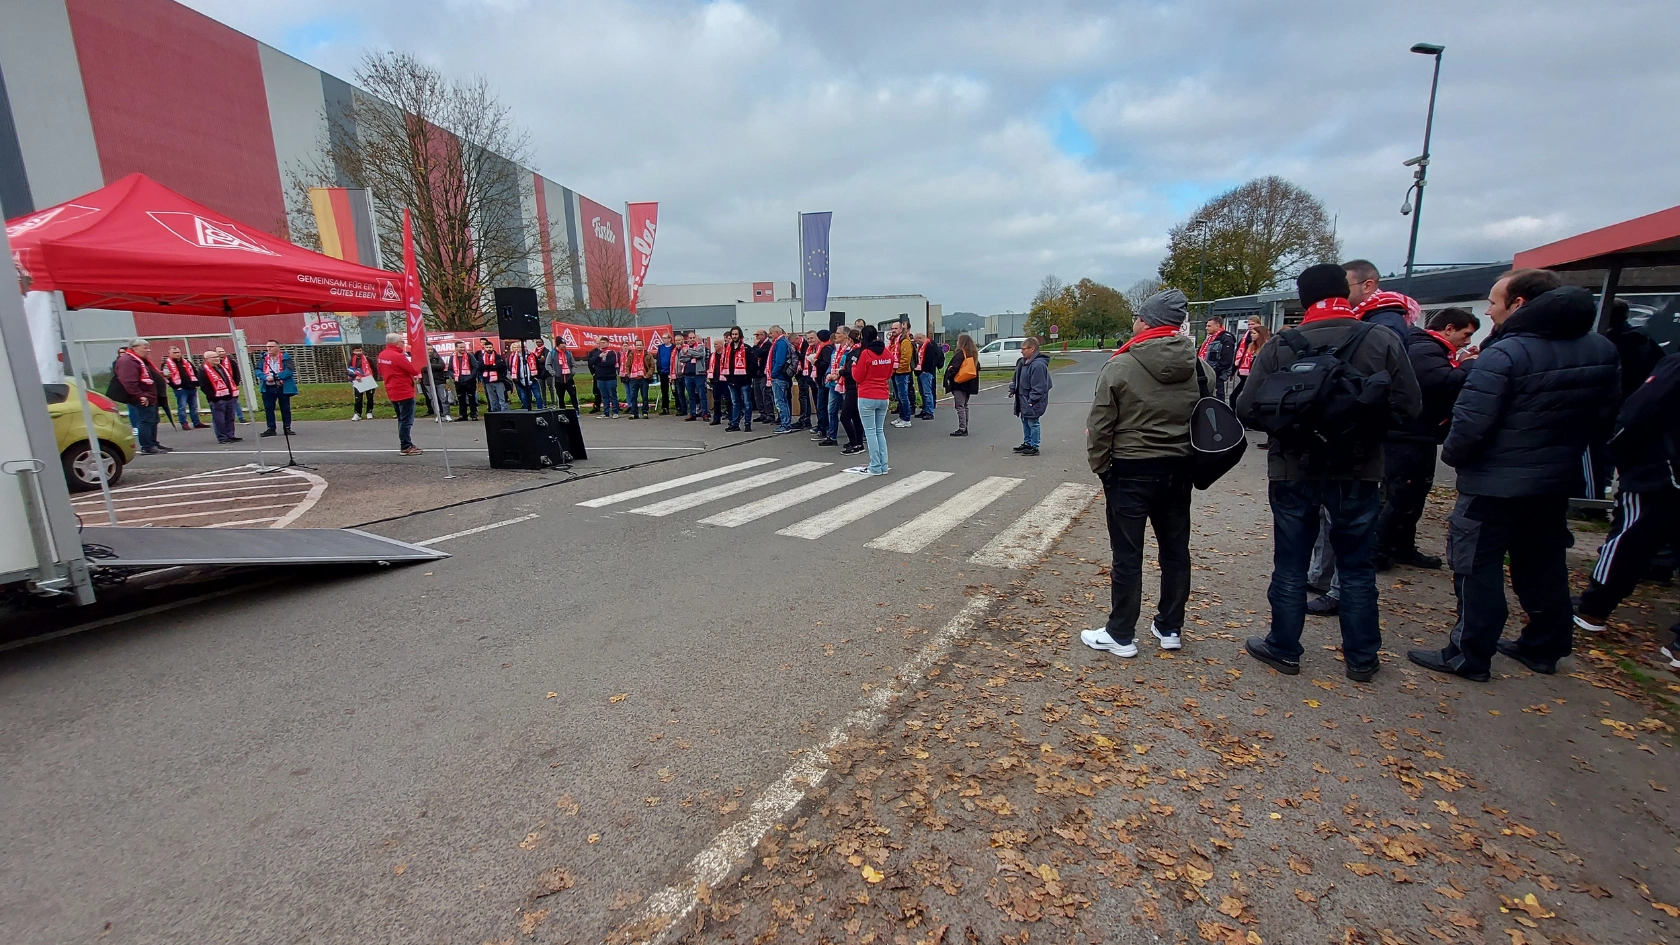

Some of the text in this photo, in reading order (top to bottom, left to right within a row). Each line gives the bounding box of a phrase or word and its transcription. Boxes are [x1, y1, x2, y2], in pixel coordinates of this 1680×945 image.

[592, 217, 616, 244] Fissler
[297, 274, 376, 291] GEMEINSAM FÜR EIN
[330, 287, 377, 300] GUTES LEBEN
